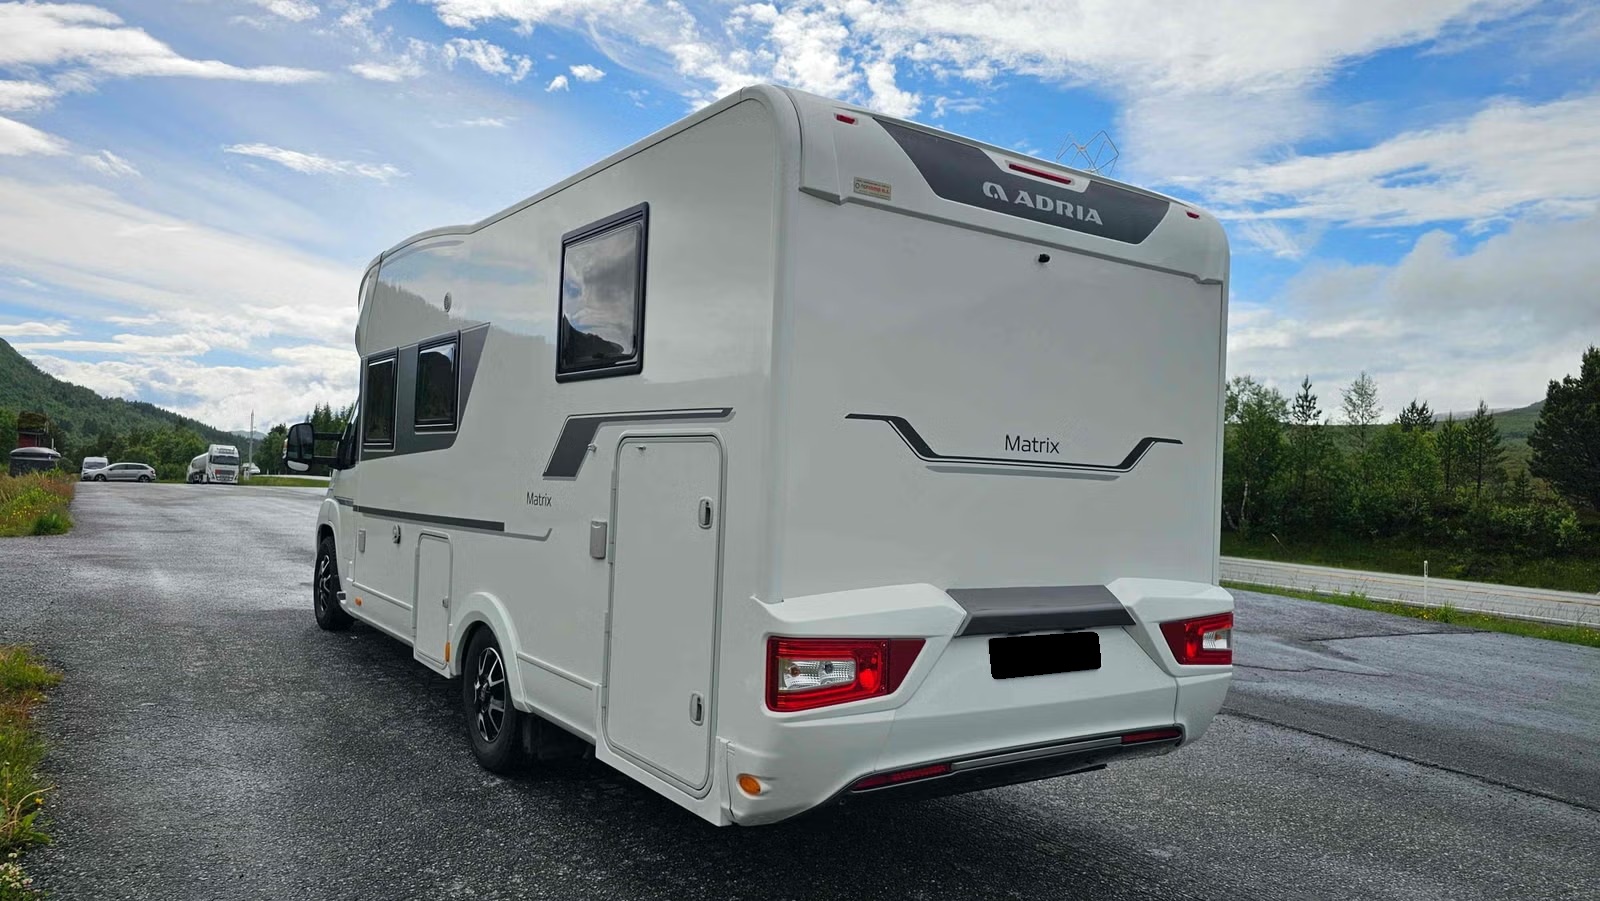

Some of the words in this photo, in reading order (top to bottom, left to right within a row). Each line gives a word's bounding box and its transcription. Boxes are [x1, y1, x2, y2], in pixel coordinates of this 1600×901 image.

[1014, 190, 1103, 225] ADRIA
[1005, 434, 1060, 454] Matrix
[527, 491, 552, 507] Matrix
